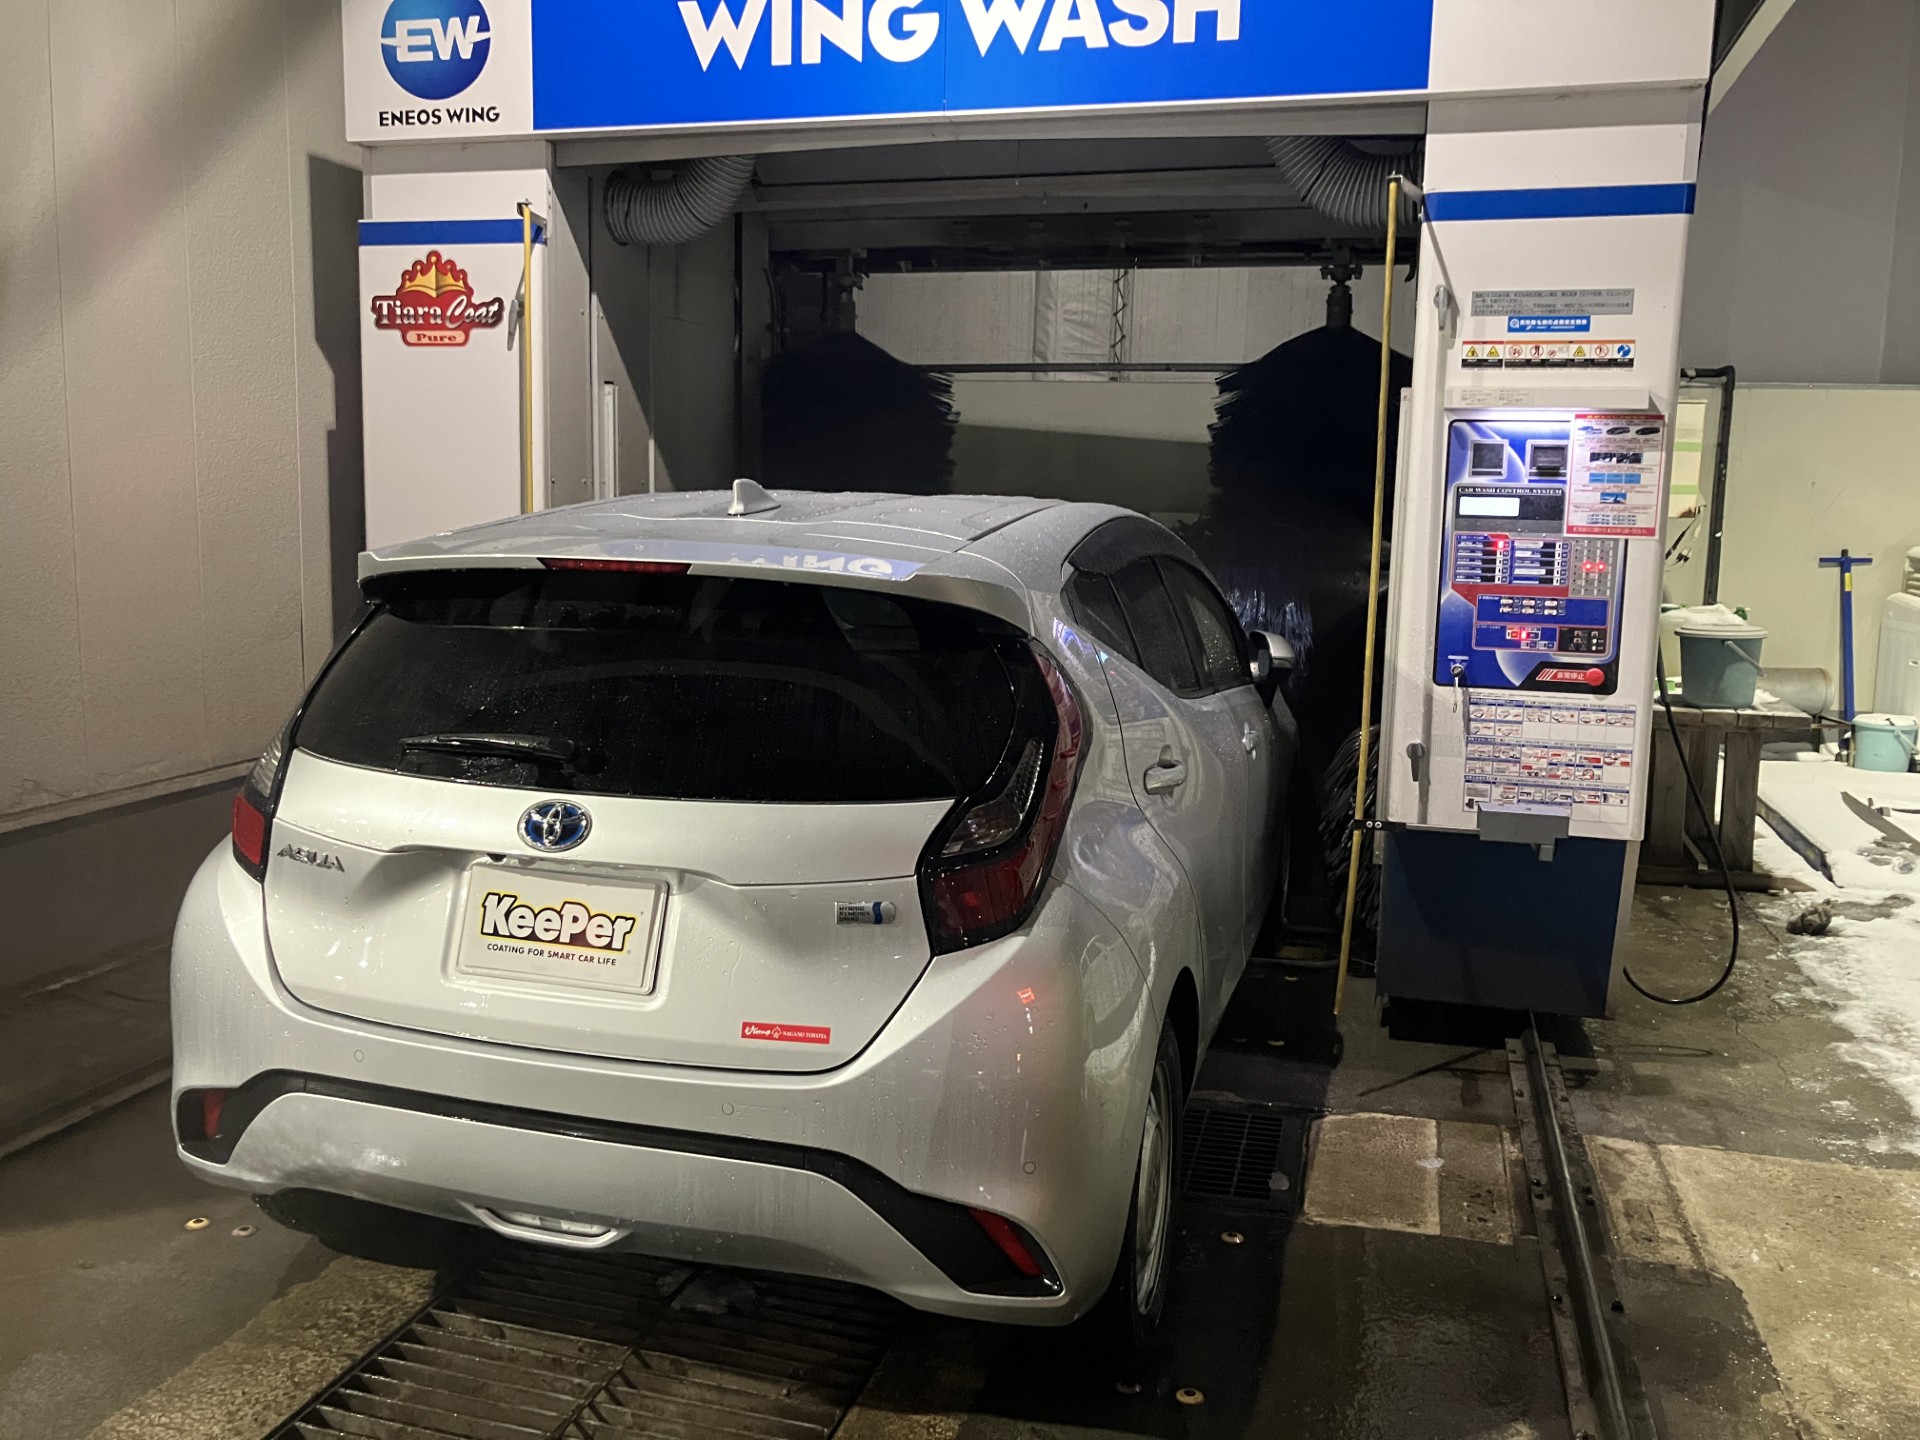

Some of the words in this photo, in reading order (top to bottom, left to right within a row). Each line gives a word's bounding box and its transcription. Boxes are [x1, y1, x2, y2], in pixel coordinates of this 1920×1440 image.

[394, 15, 481, 63] EW
[677, 0, 940, 73] WING
[960, 0, 1241, 58] WASH
[379, 108, 442, 127] ENEOS
[445, 106, 500, 124] WING
[376, 299, 442, 325] Tiara
[445, 294, 500, 329] Coat
[415, 333, 457, 342] Pure
[481, 892, 636, 951] KeePer
[487, 943, 525, 955] COATING
[527, 947, 545, 957] FOR
[547, 950, 576, 961] SMART
[578, 954, 595, 964] CAR
[597, 957, 617, 966] LIFE
